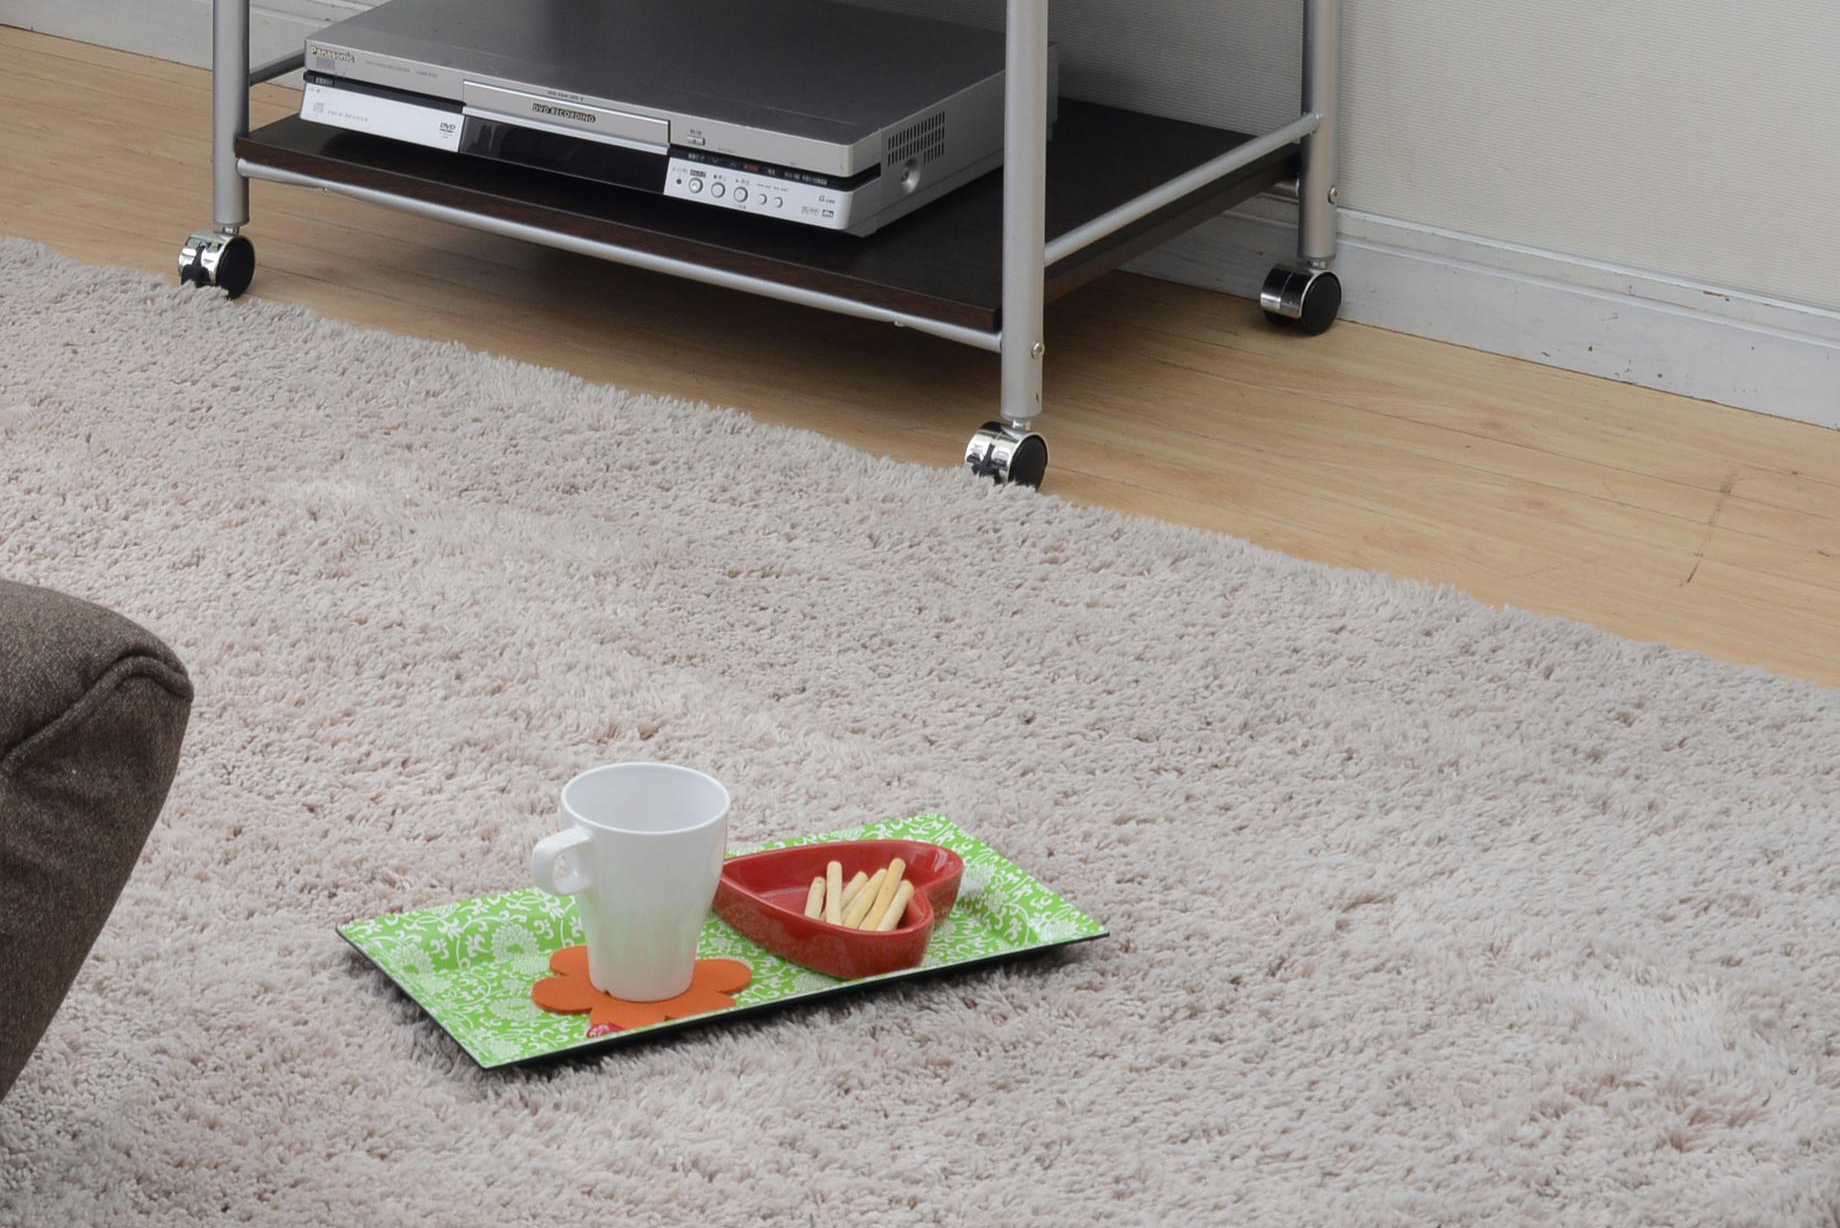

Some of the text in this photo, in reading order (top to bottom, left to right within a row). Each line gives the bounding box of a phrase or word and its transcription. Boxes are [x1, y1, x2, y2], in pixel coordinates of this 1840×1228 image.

[310, 45, 355, 64] Panasonic
[533, 103, 596, 123] DVD RECORDING
[439, 121, 456, 130] DVD
